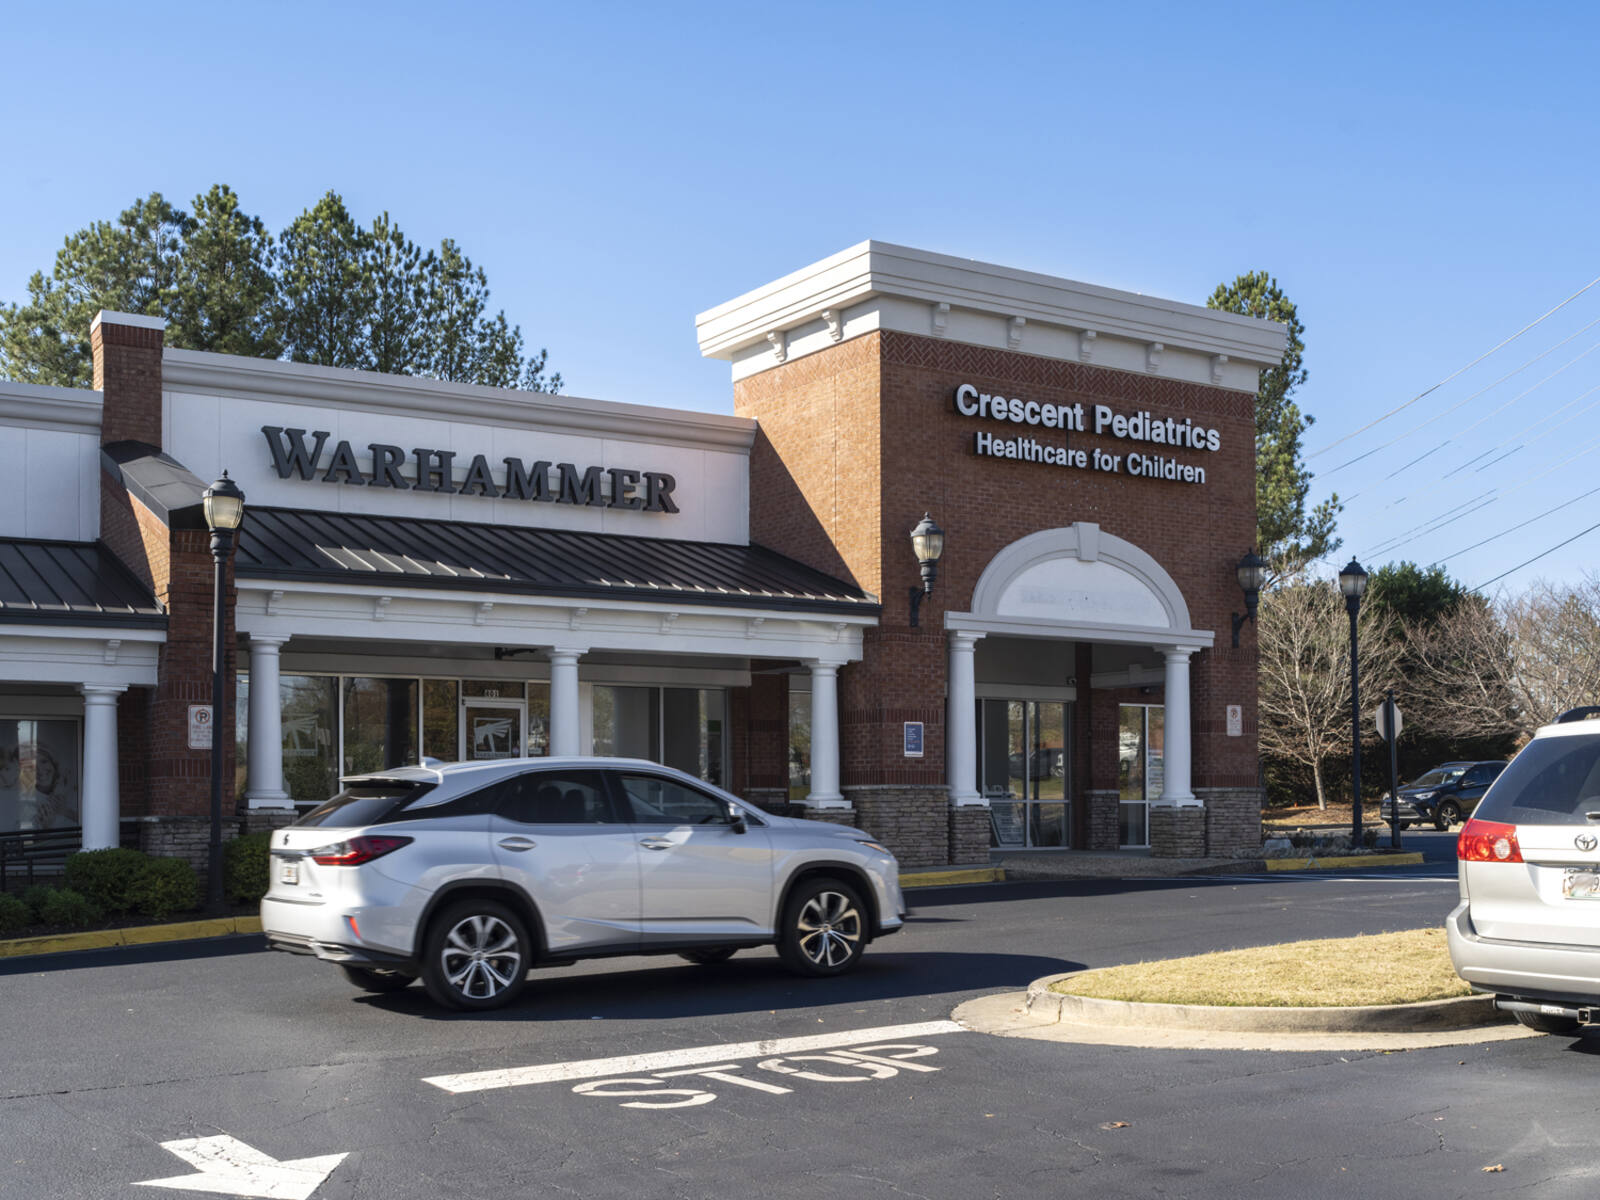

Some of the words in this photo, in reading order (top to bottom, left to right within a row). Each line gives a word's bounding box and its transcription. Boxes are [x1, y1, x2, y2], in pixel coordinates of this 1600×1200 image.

[956, 383, 1084, 432] Crescent
[1094, 404, 1221, 451] Pediatrics
[261, 425, 680, 514] WARHAMMER
[976, 431, 1088, 468] Healthcare
[1093, 447, 1121, 472] for
[1126, 452, 1206, 484] Children
[572, 1044, 942, 1109] STOP
